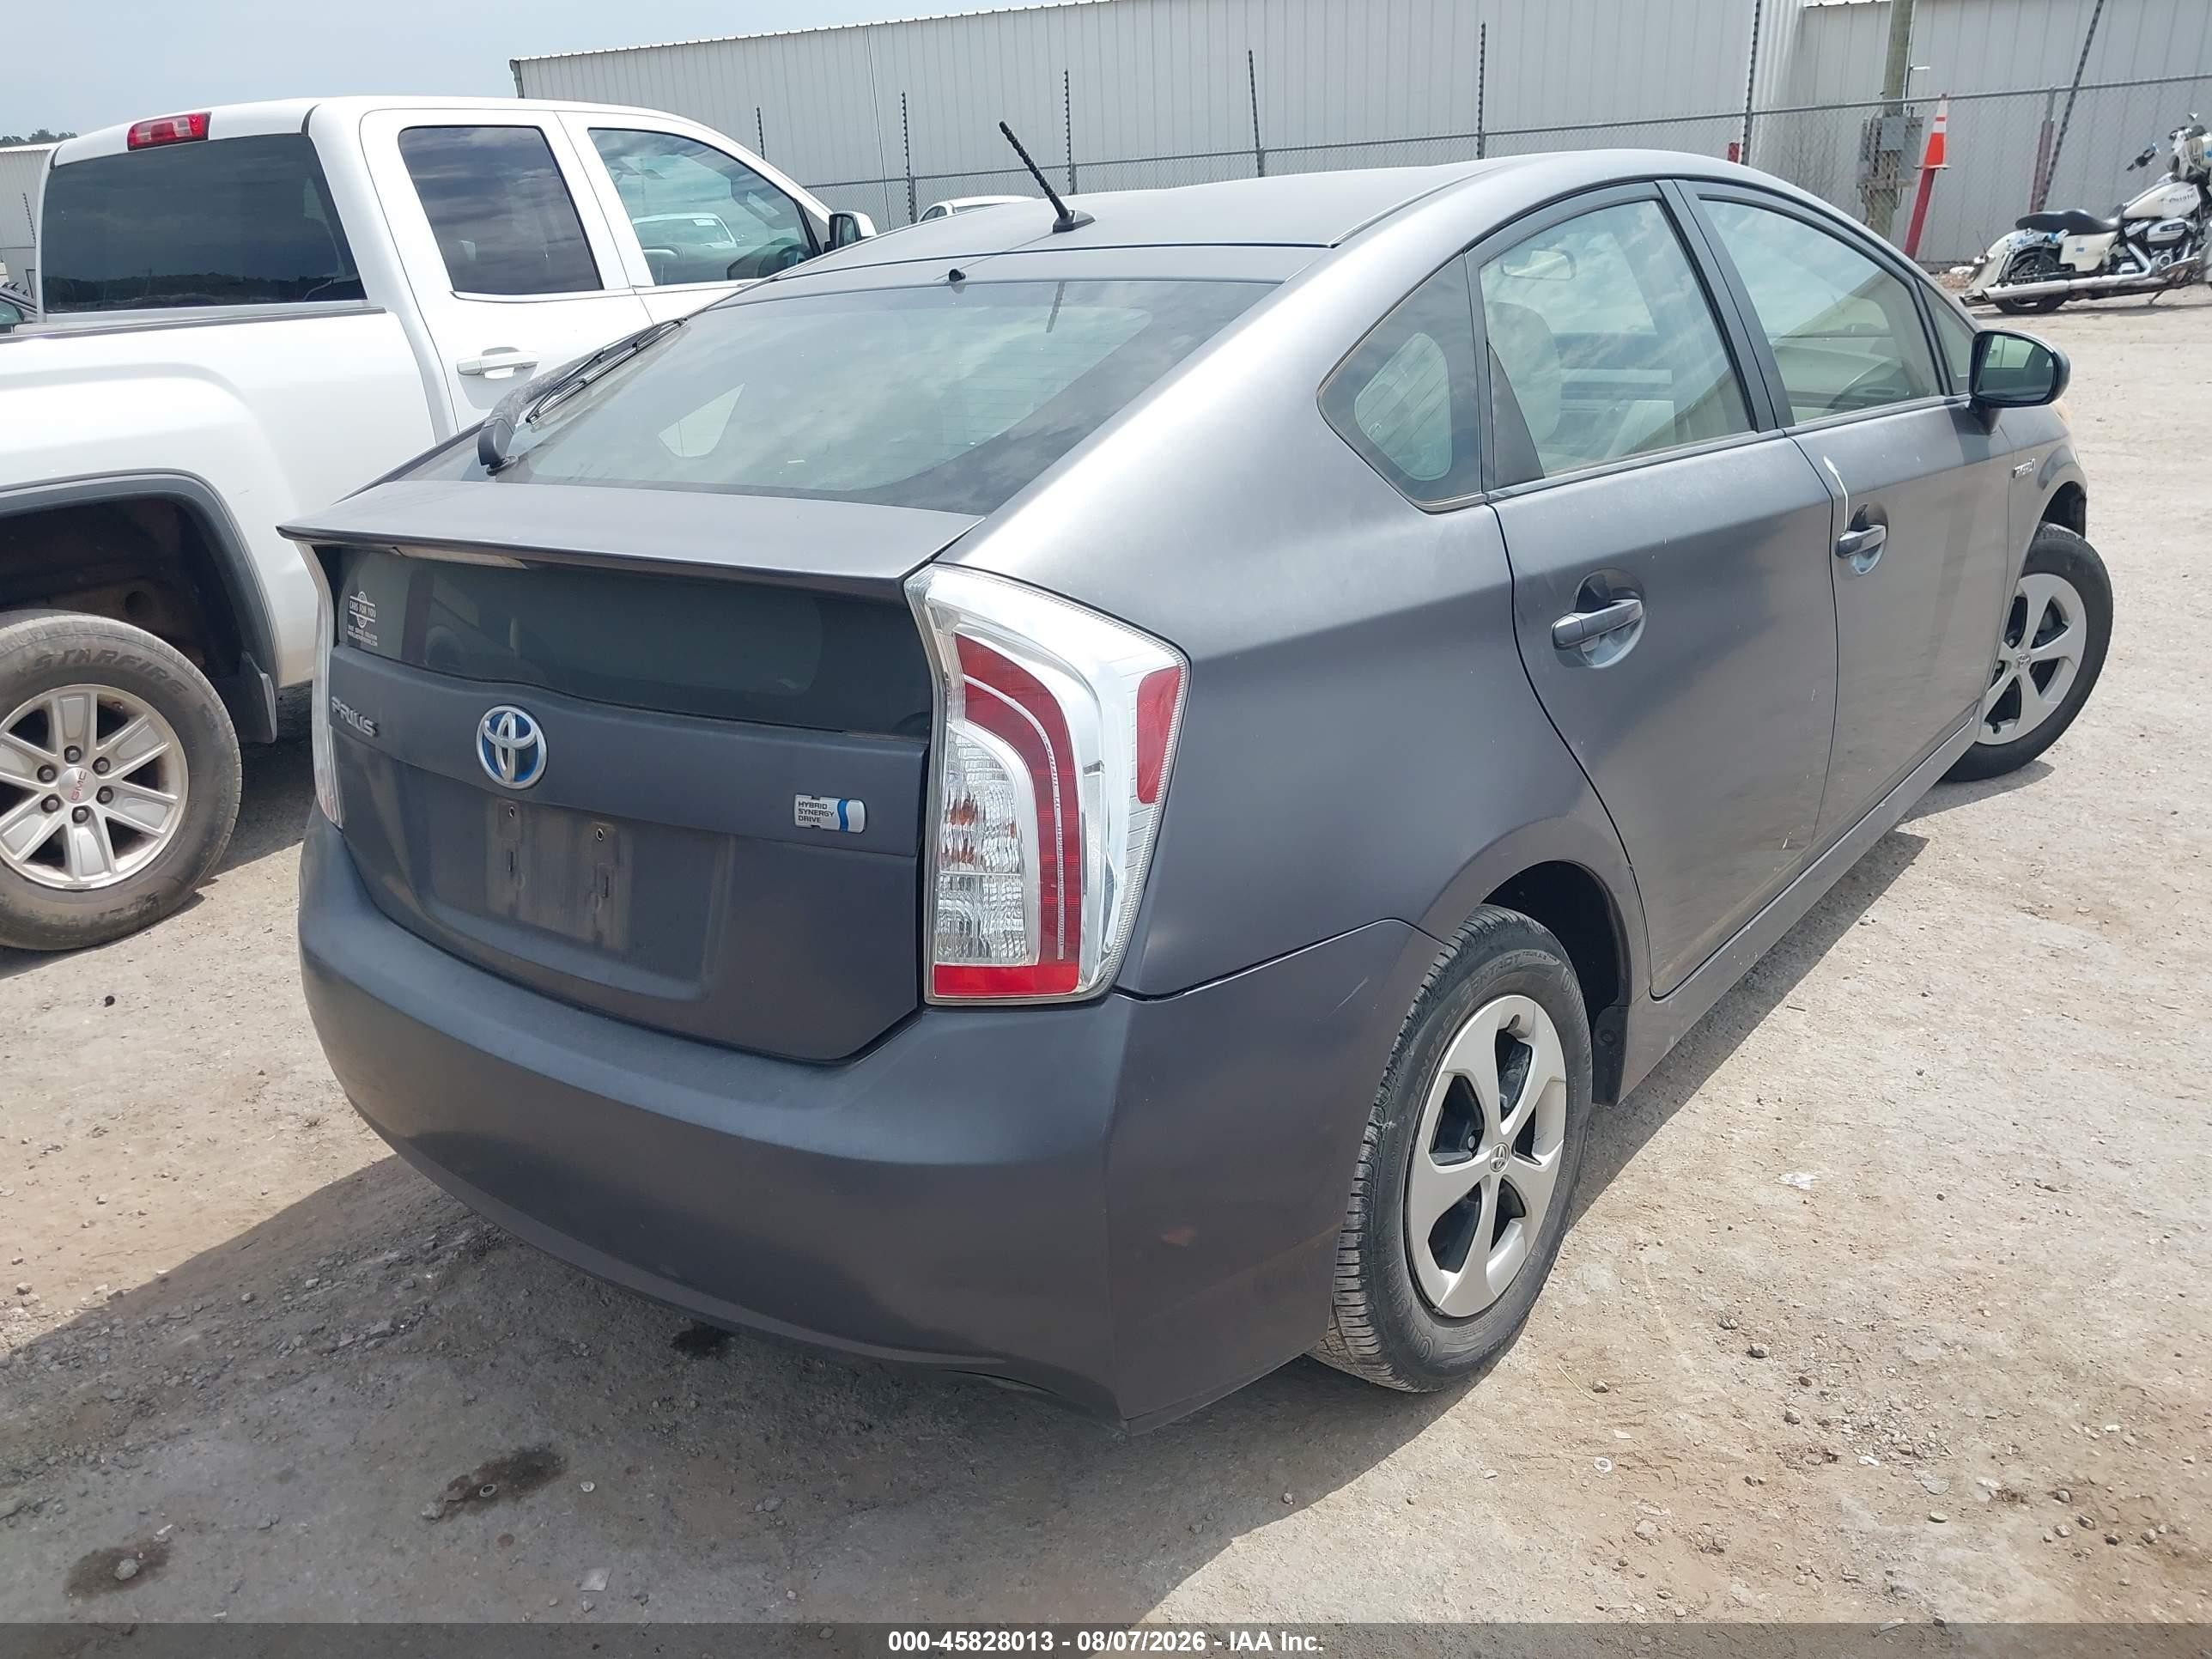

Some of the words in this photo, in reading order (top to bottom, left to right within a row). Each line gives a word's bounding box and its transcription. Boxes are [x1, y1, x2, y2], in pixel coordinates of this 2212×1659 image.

[349, 600, 359, 611] CARS
[368, 608, 377, 619] YOU
[33, 648, 189, 694] STARFIRE
[331, 696, 376, 738] PRIUS
[70, 770, 88, 801] GMC
[798, 800, 828, 810] HYBRID
[798, 808, 835, 817] SYNERGY
[798, 815, 823, 823] DRIVE
